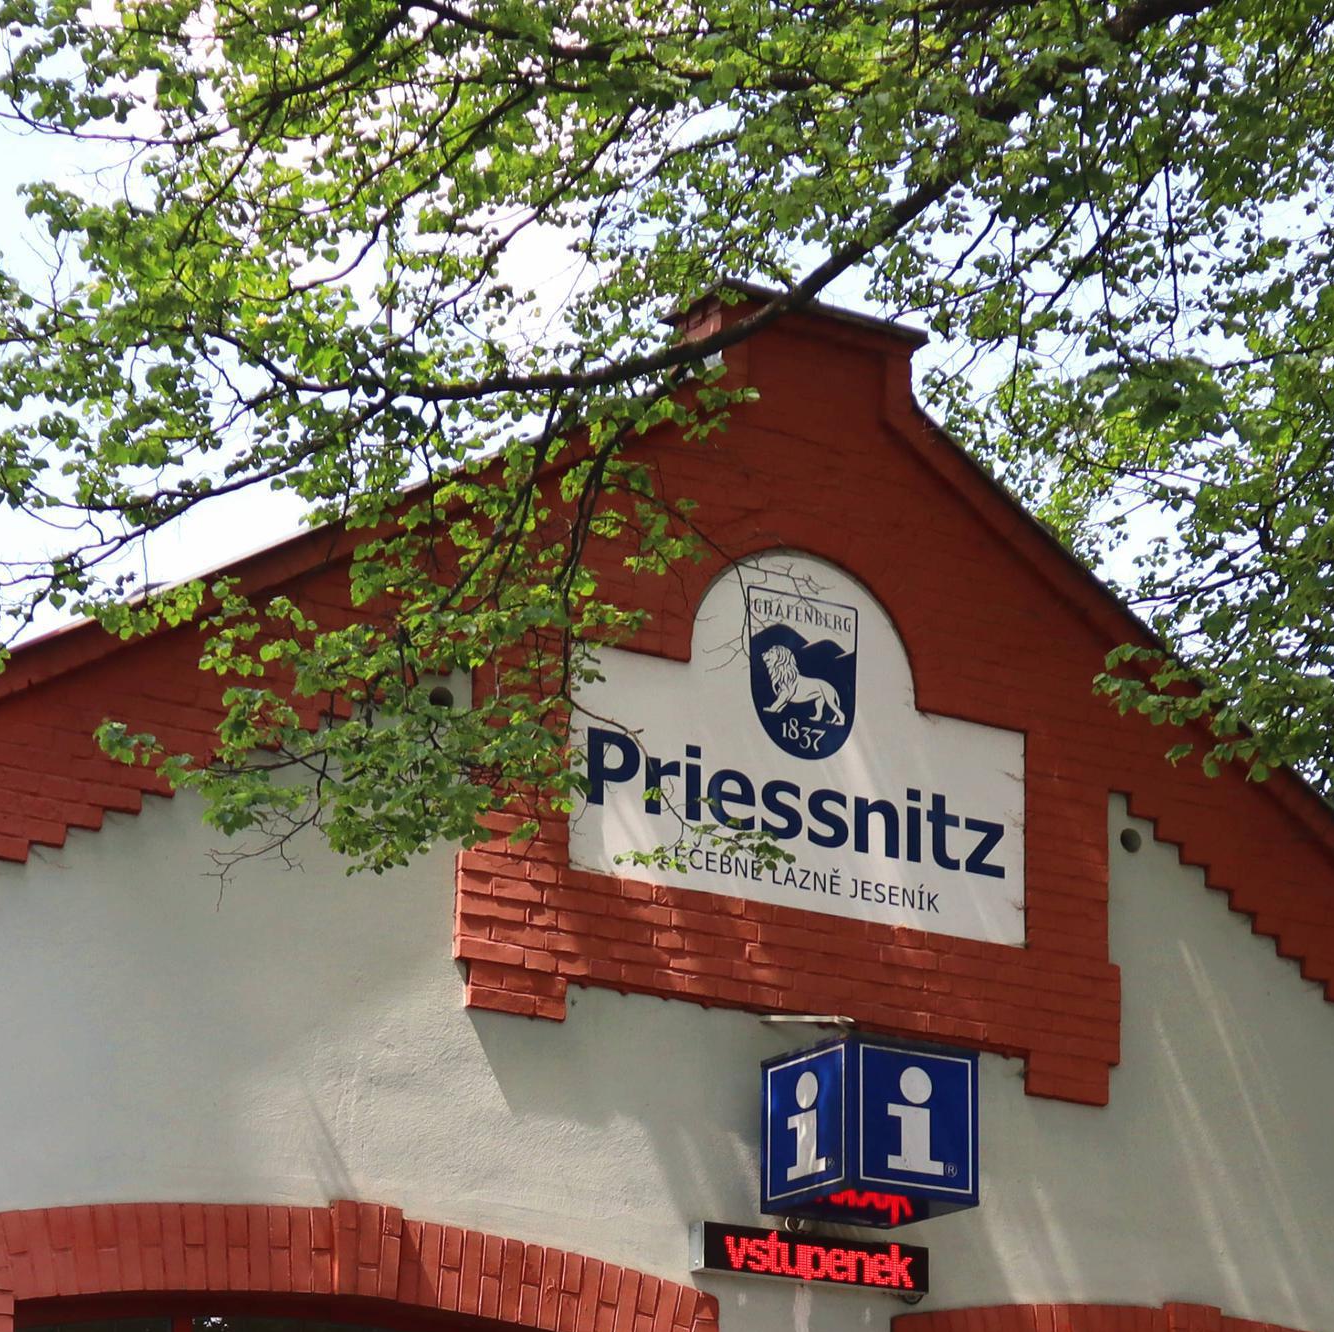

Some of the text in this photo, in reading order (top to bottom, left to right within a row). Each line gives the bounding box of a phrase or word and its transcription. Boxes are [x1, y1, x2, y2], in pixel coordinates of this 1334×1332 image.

[781, 718, 826, 752] 1837
[586, 726, 1006, 879] Priessnitz
[849, 876, 940, 914] JESENÍK
[723, 1230, 915, 1289] vstupenek
